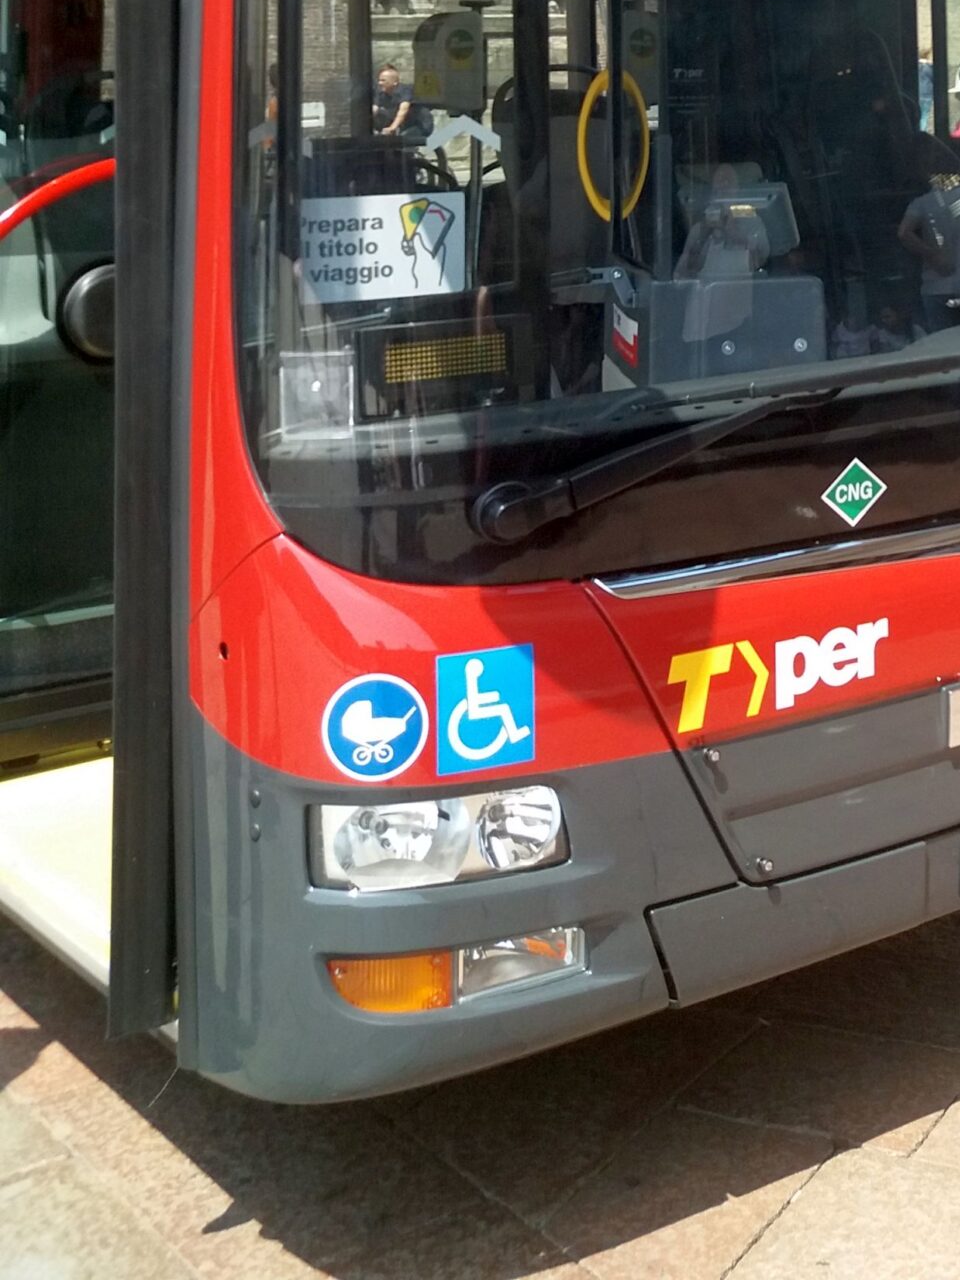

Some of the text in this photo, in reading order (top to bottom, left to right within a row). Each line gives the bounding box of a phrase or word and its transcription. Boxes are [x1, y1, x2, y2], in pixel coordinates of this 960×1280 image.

[318, 238, 378, 258] titolo
[310, 261, 393, 286] viaggio
[835, 480, 873, 504] CNG
